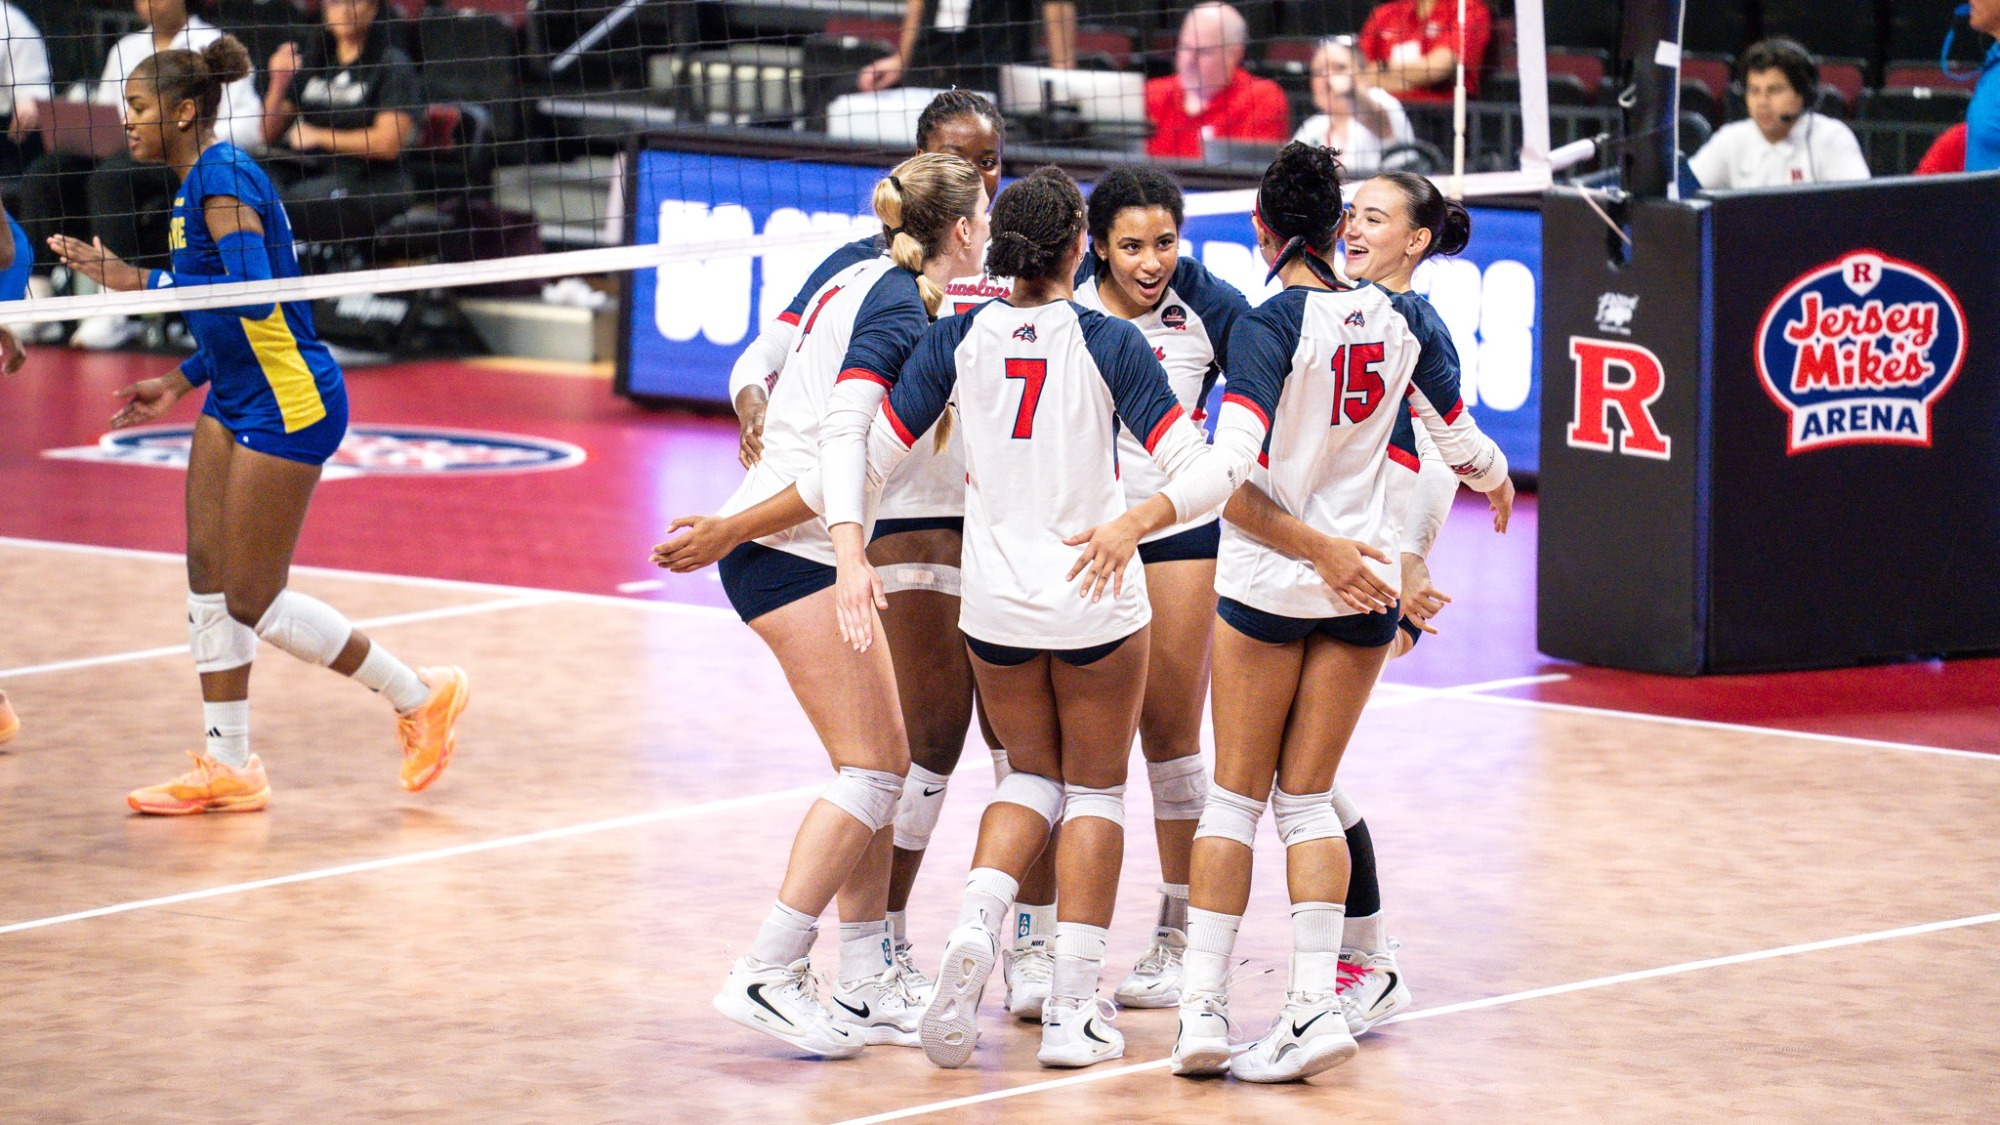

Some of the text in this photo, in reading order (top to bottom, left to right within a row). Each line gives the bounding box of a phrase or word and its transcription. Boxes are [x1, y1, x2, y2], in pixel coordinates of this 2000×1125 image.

[944, 276, 1011, 299] awolves
[1852, 262, 1873, 284] R
[1785, 293, 1937, 347] Jersey
[1330, 341, 1386, 426] 15
[1792, 339, 1934, 391] Mike's
[1005, 357, 1048, 439] 7
[1567, 336, 1671, 461] R
[1801, 403, 1919, 442] ARENA
